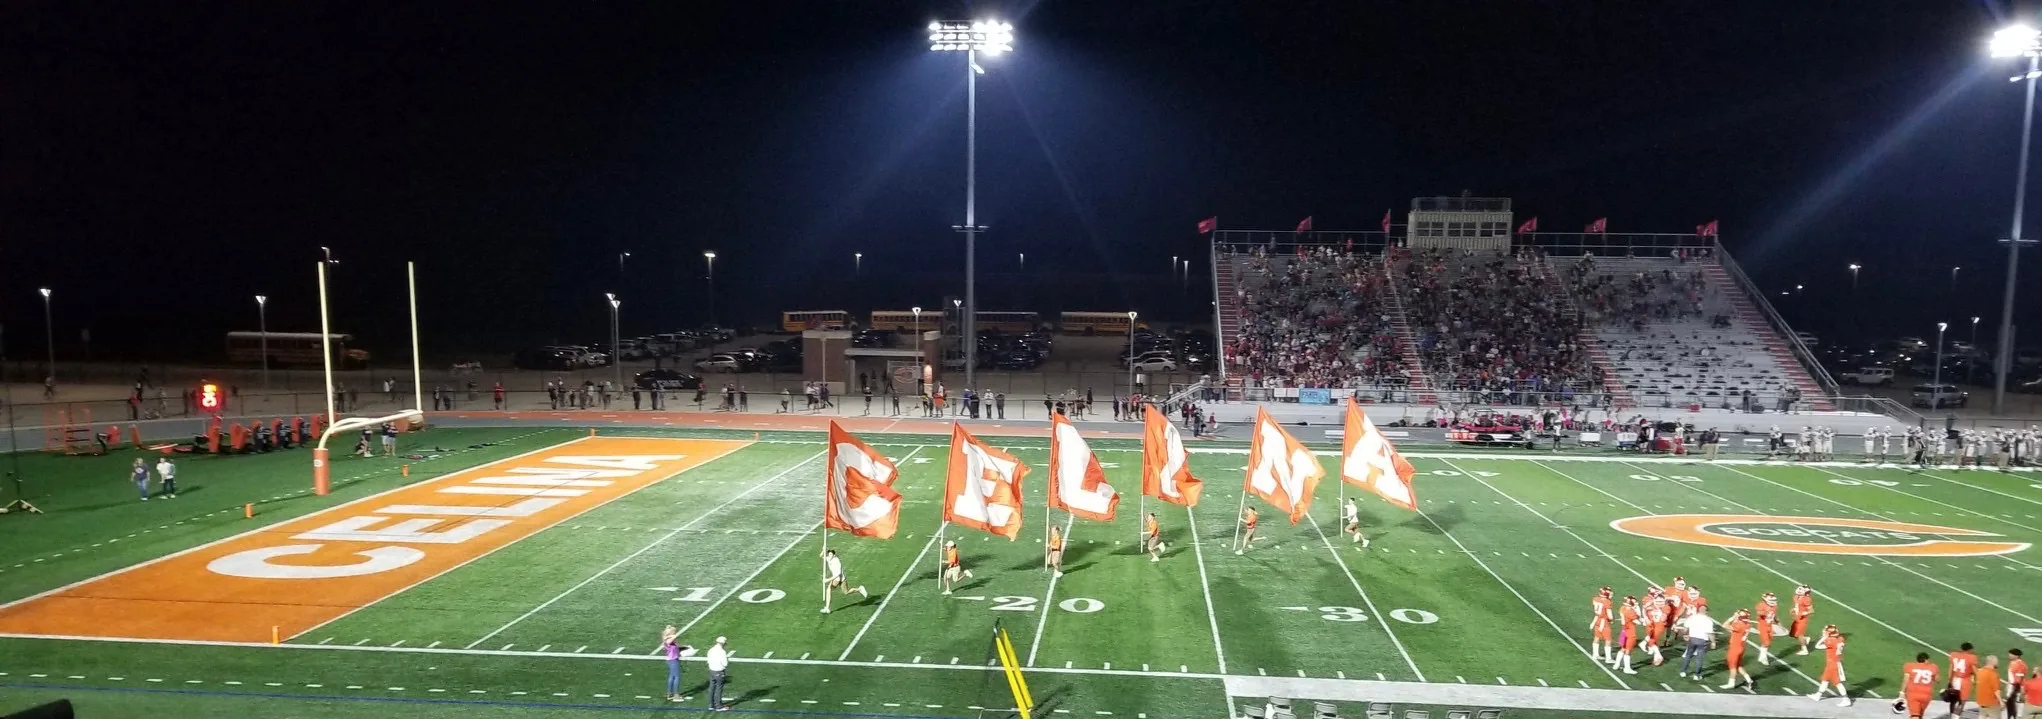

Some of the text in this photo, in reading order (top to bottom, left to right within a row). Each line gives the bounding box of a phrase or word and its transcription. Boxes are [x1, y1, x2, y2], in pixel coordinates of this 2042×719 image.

[833, 442, 894, 528] C
[954, 438, 1018, 527] E
[1056, 422, 1115, 514] L
[1160, 422, 1186, 498] I
[1251, 419, 1317, 512] N
[1343, 412, 1413, 505] A
[206, 454, 688, 579] CELINA
[1717, 526, 1921, 541] BOBCATS
[1911, 668, 1933, 685] 79
